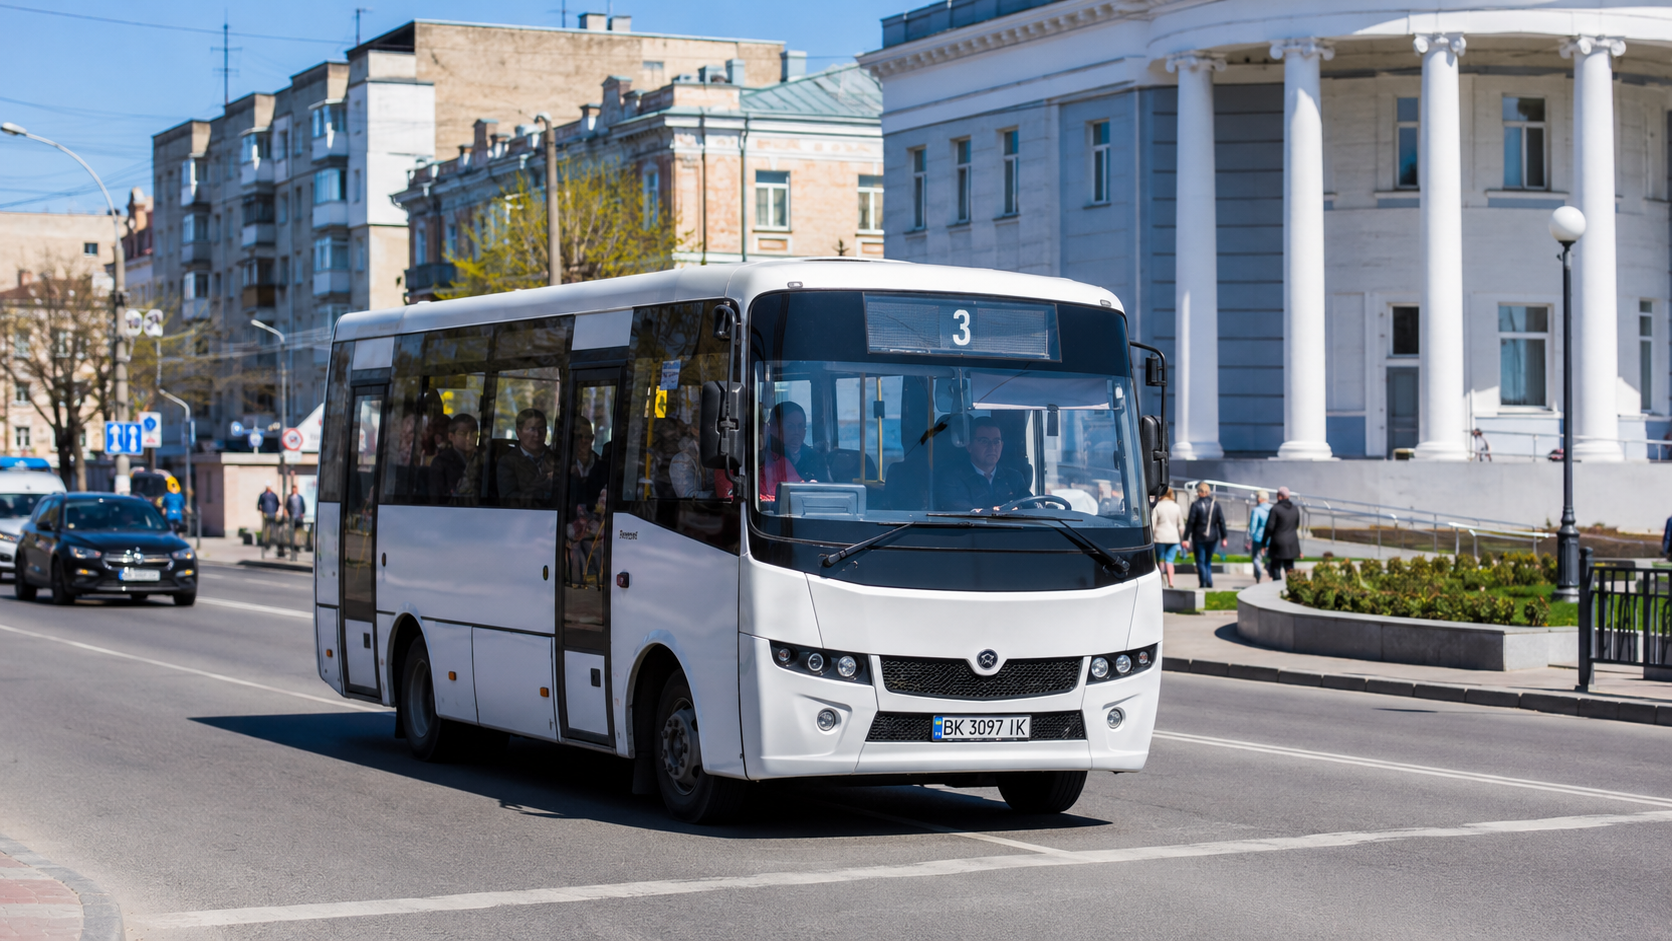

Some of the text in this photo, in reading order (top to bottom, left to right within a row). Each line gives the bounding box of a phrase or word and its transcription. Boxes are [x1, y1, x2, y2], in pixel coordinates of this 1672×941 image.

[952, 309, 971, 346] 3
[943, 718, 1027, 736] BK 3097 IK
